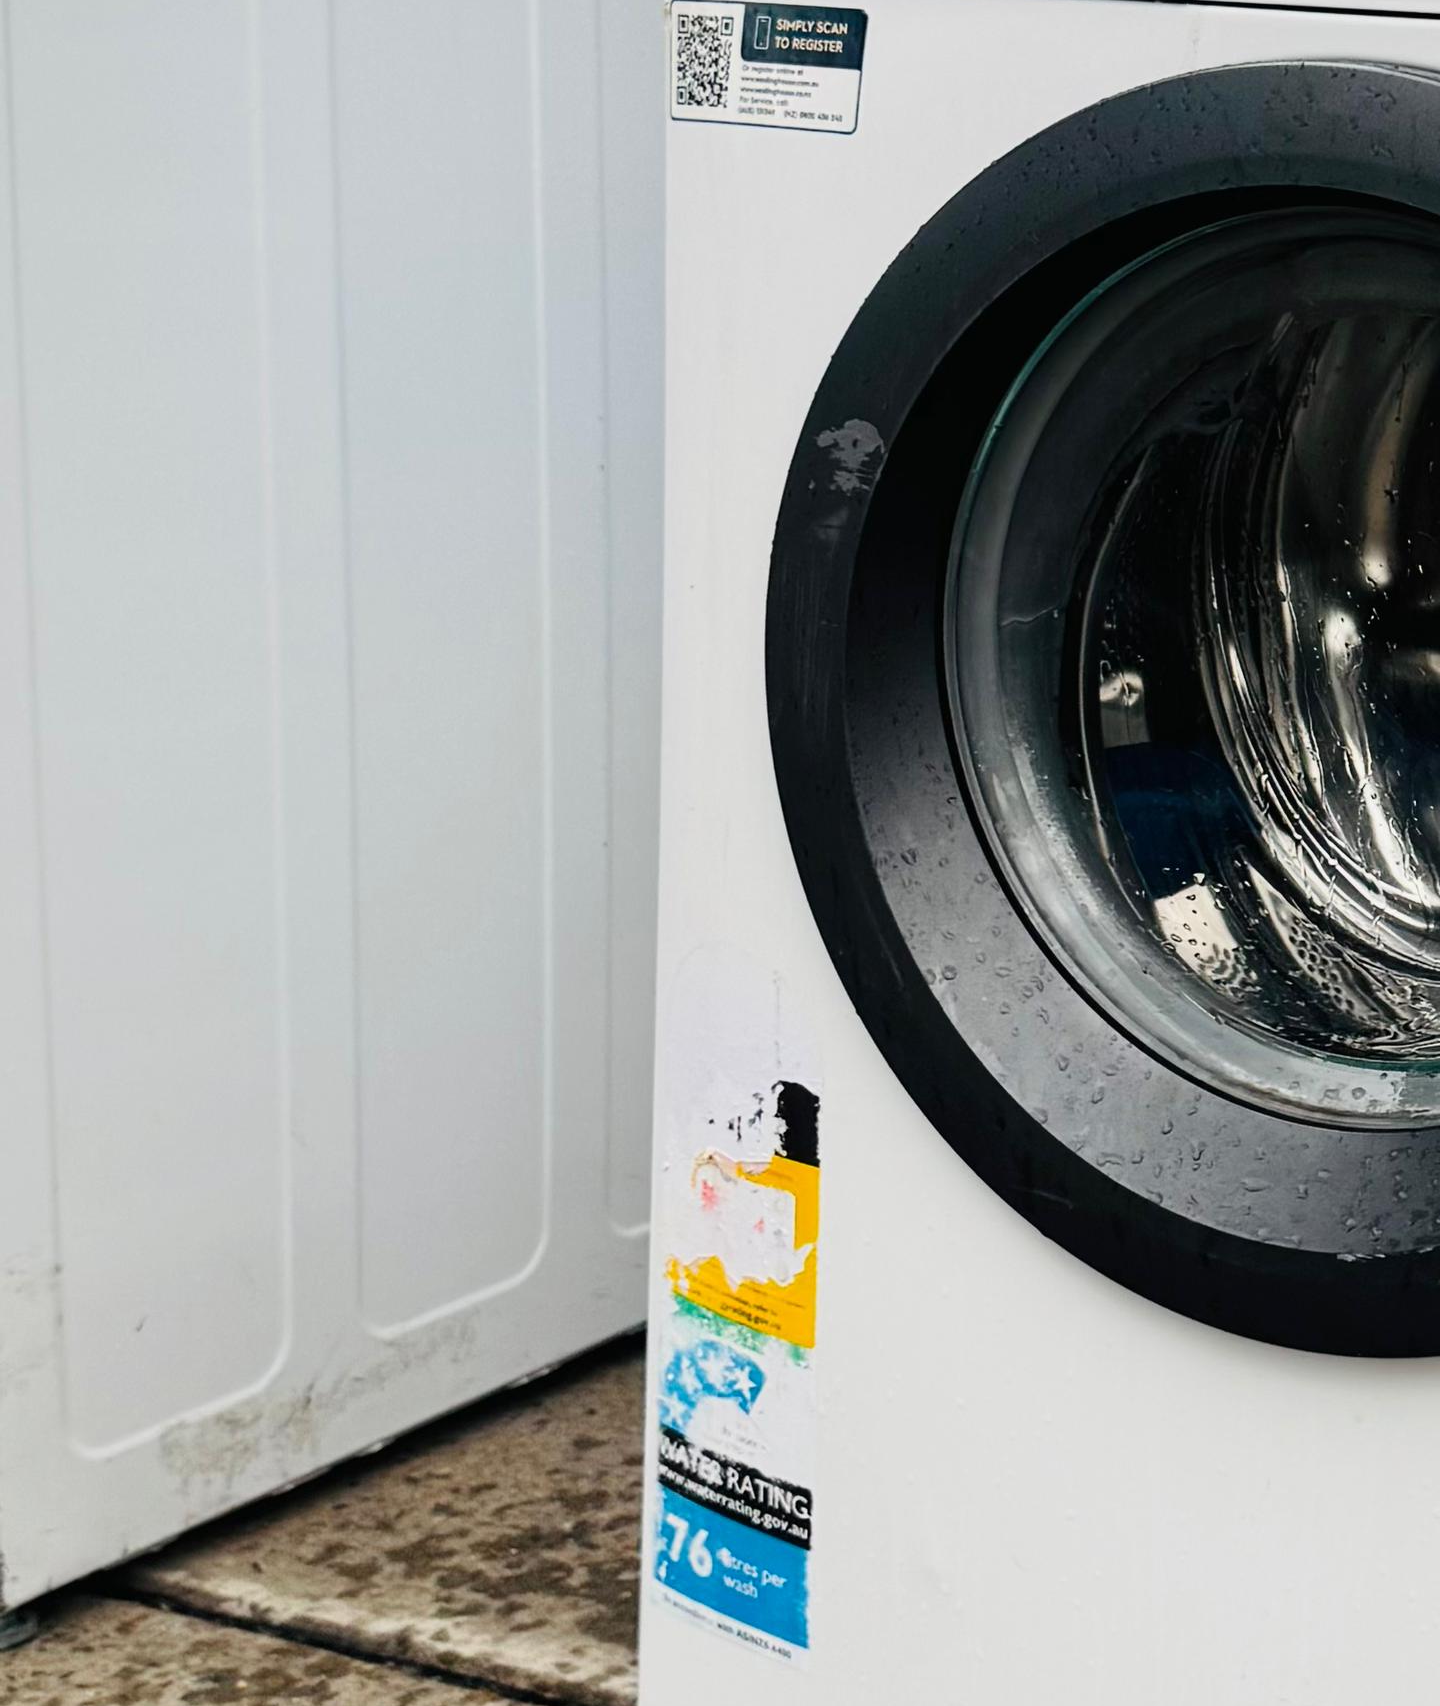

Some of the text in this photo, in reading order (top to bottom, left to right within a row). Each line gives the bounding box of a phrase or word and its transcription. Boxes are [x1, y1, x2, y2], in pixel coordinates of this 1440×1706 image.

[776, 19, 848, 35] SIMPLY SCAN
[774, 36, 843, 53] TO REGISTER
[661, 1436, 723, 1487] WATER
[726, 1466, 812, 1520] RATING
[666, 1512, 713, 1578] 76
[723, 1574, 758, 1599] wash
[761, 1570, 787, 1589] per
